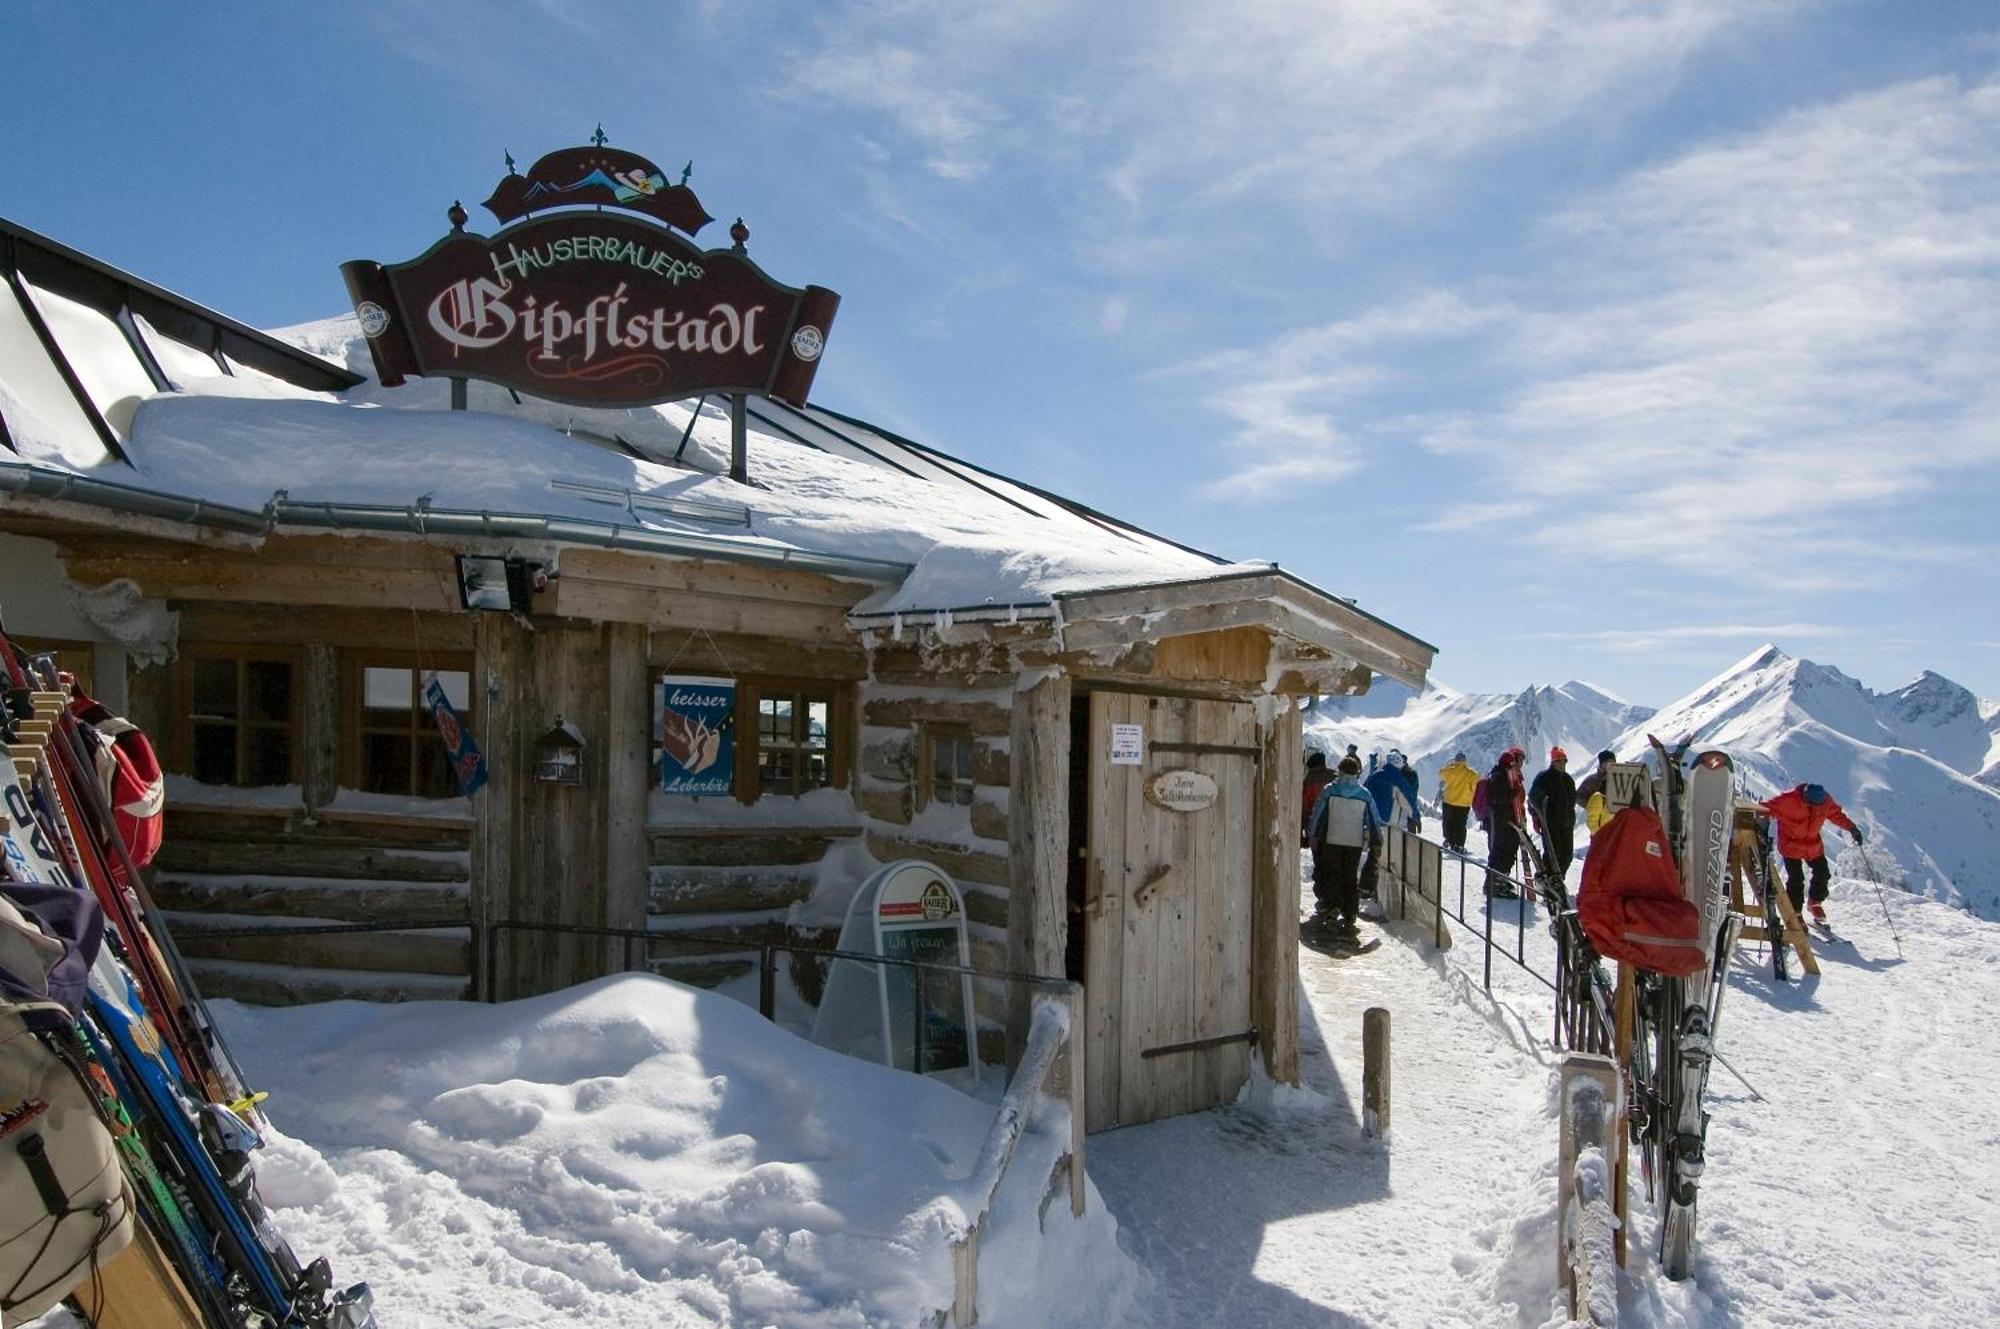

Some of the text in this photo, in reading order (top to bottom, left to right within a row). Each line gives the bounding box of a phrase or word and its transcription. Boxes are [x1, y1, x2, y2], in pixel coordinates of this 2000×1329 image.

[670, 688, 728, 707] heisser
[665, 776, 729, 792] Leberkäs
[1612, 772, 1645, 801] WC
